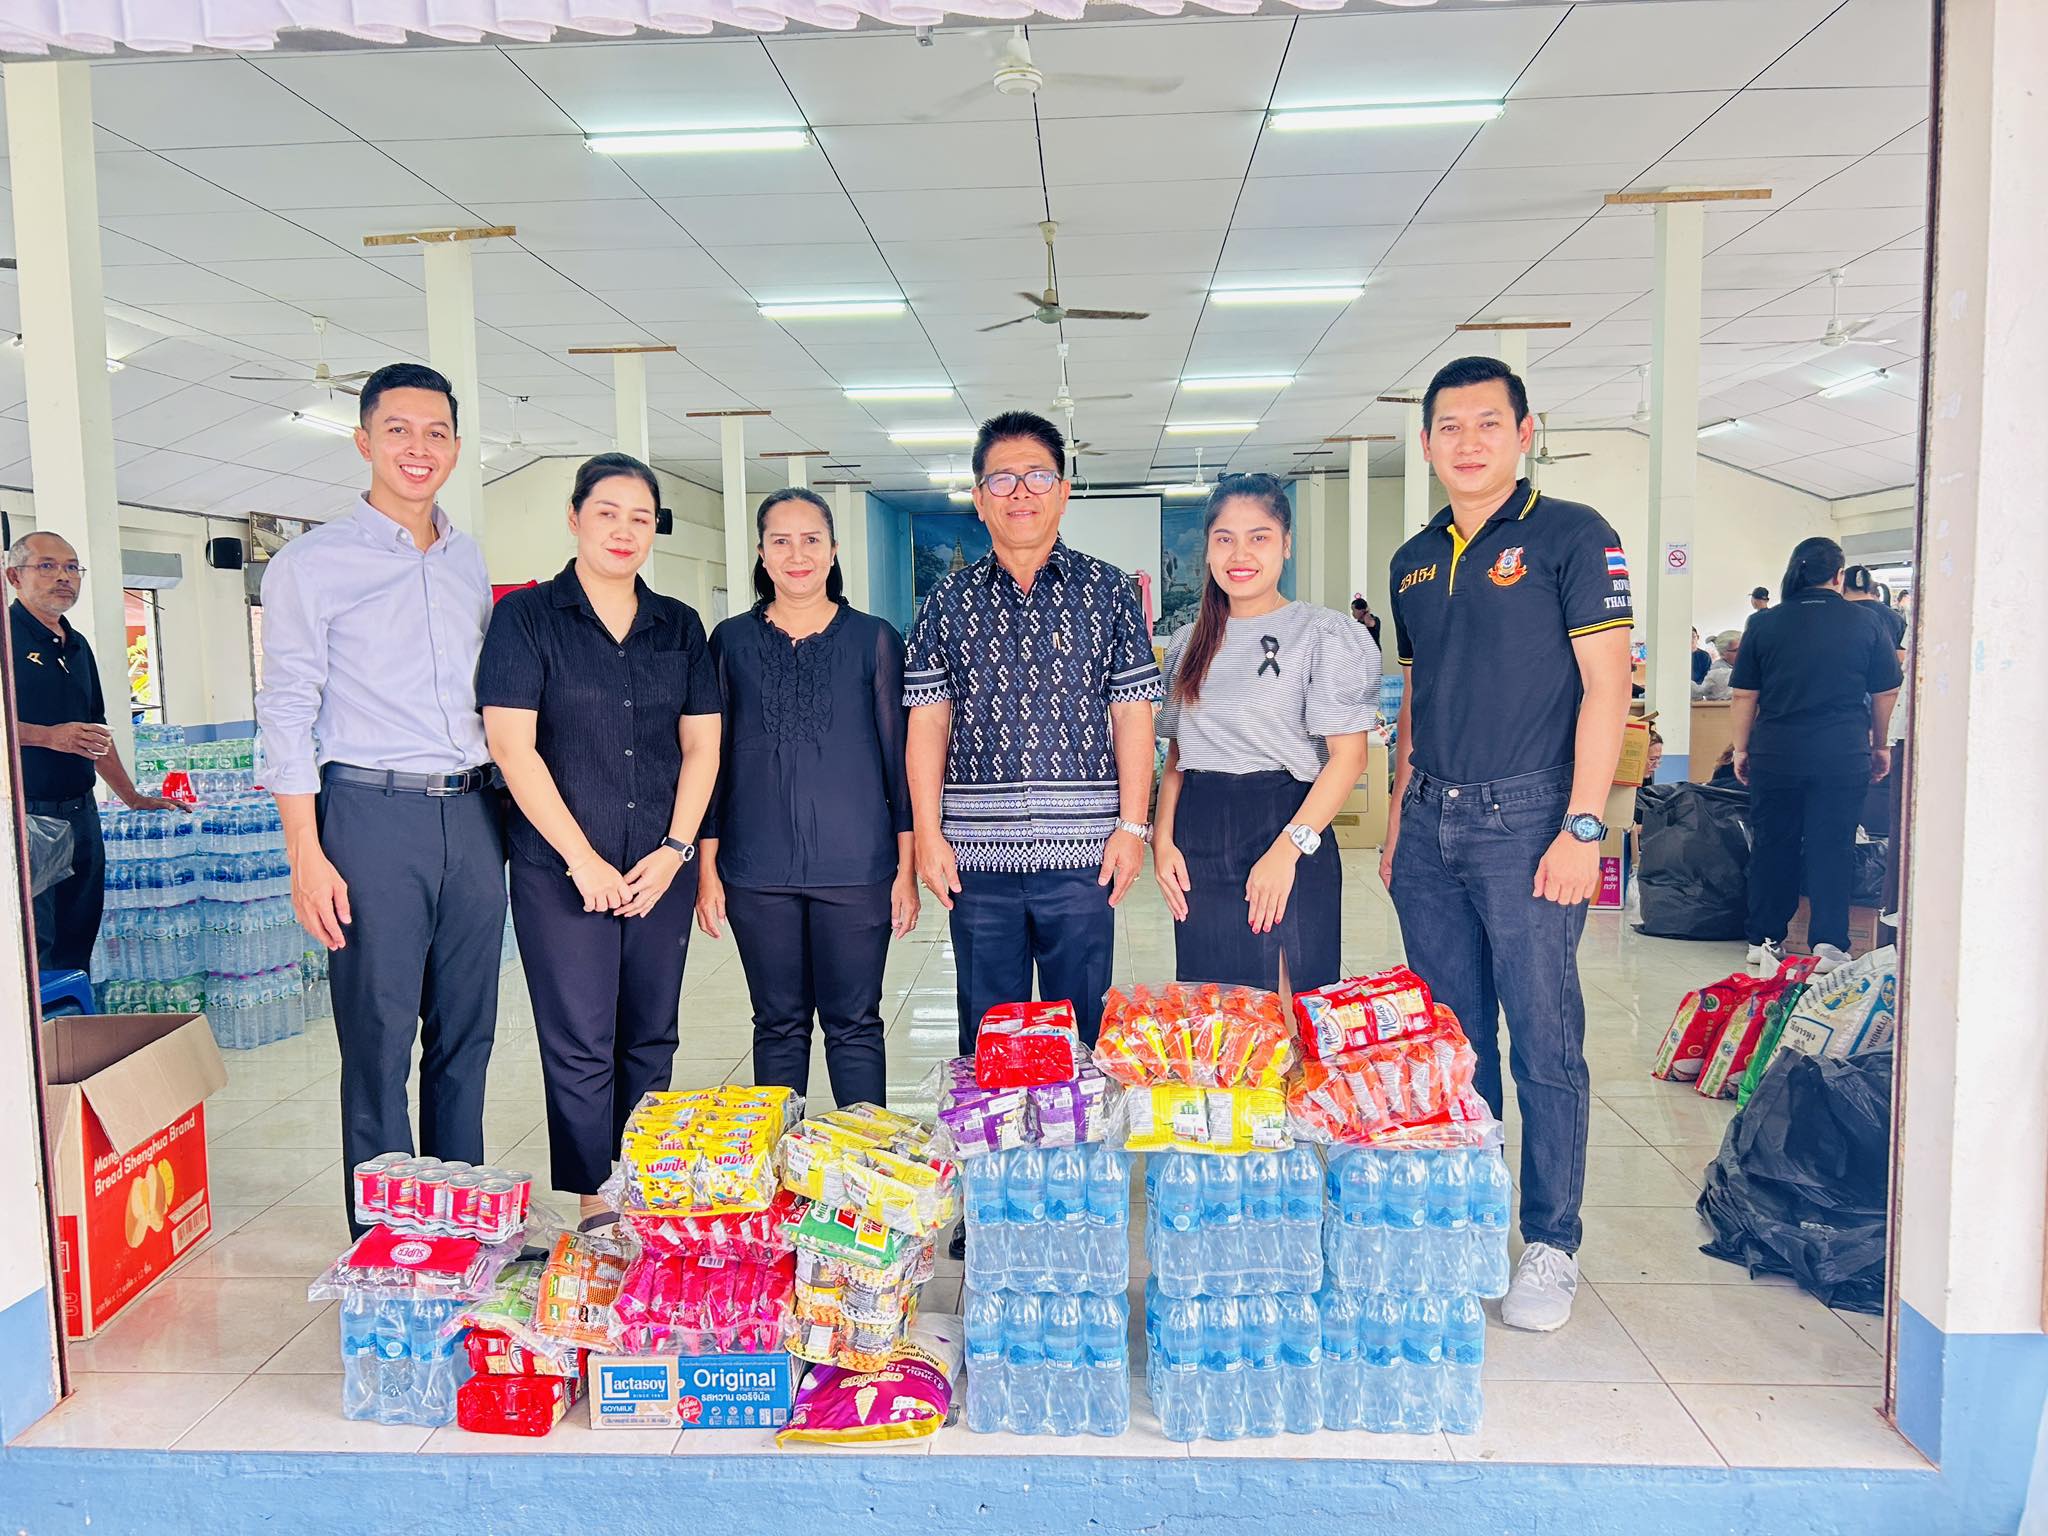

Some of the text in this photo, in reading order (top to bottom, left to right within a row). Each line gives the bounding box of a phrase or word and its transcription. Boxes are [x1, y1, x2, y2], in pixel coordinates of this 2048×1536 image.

[1604, 595, 1626, 608] THAI
[95, 1112, 195, 1198] Bread Shenghua Brand
[645, 1157, 688, 1174] แคมปัส
[397, 1246, 425, 1257] SUPER
[602, 1371, 666, 1398] Lactasoy
[693, 1368, 776, 1391] Original
[701, 1391, 770, 1402] รสหวาน ออริจินัล
[683, 1410, 690, 1419] 6
